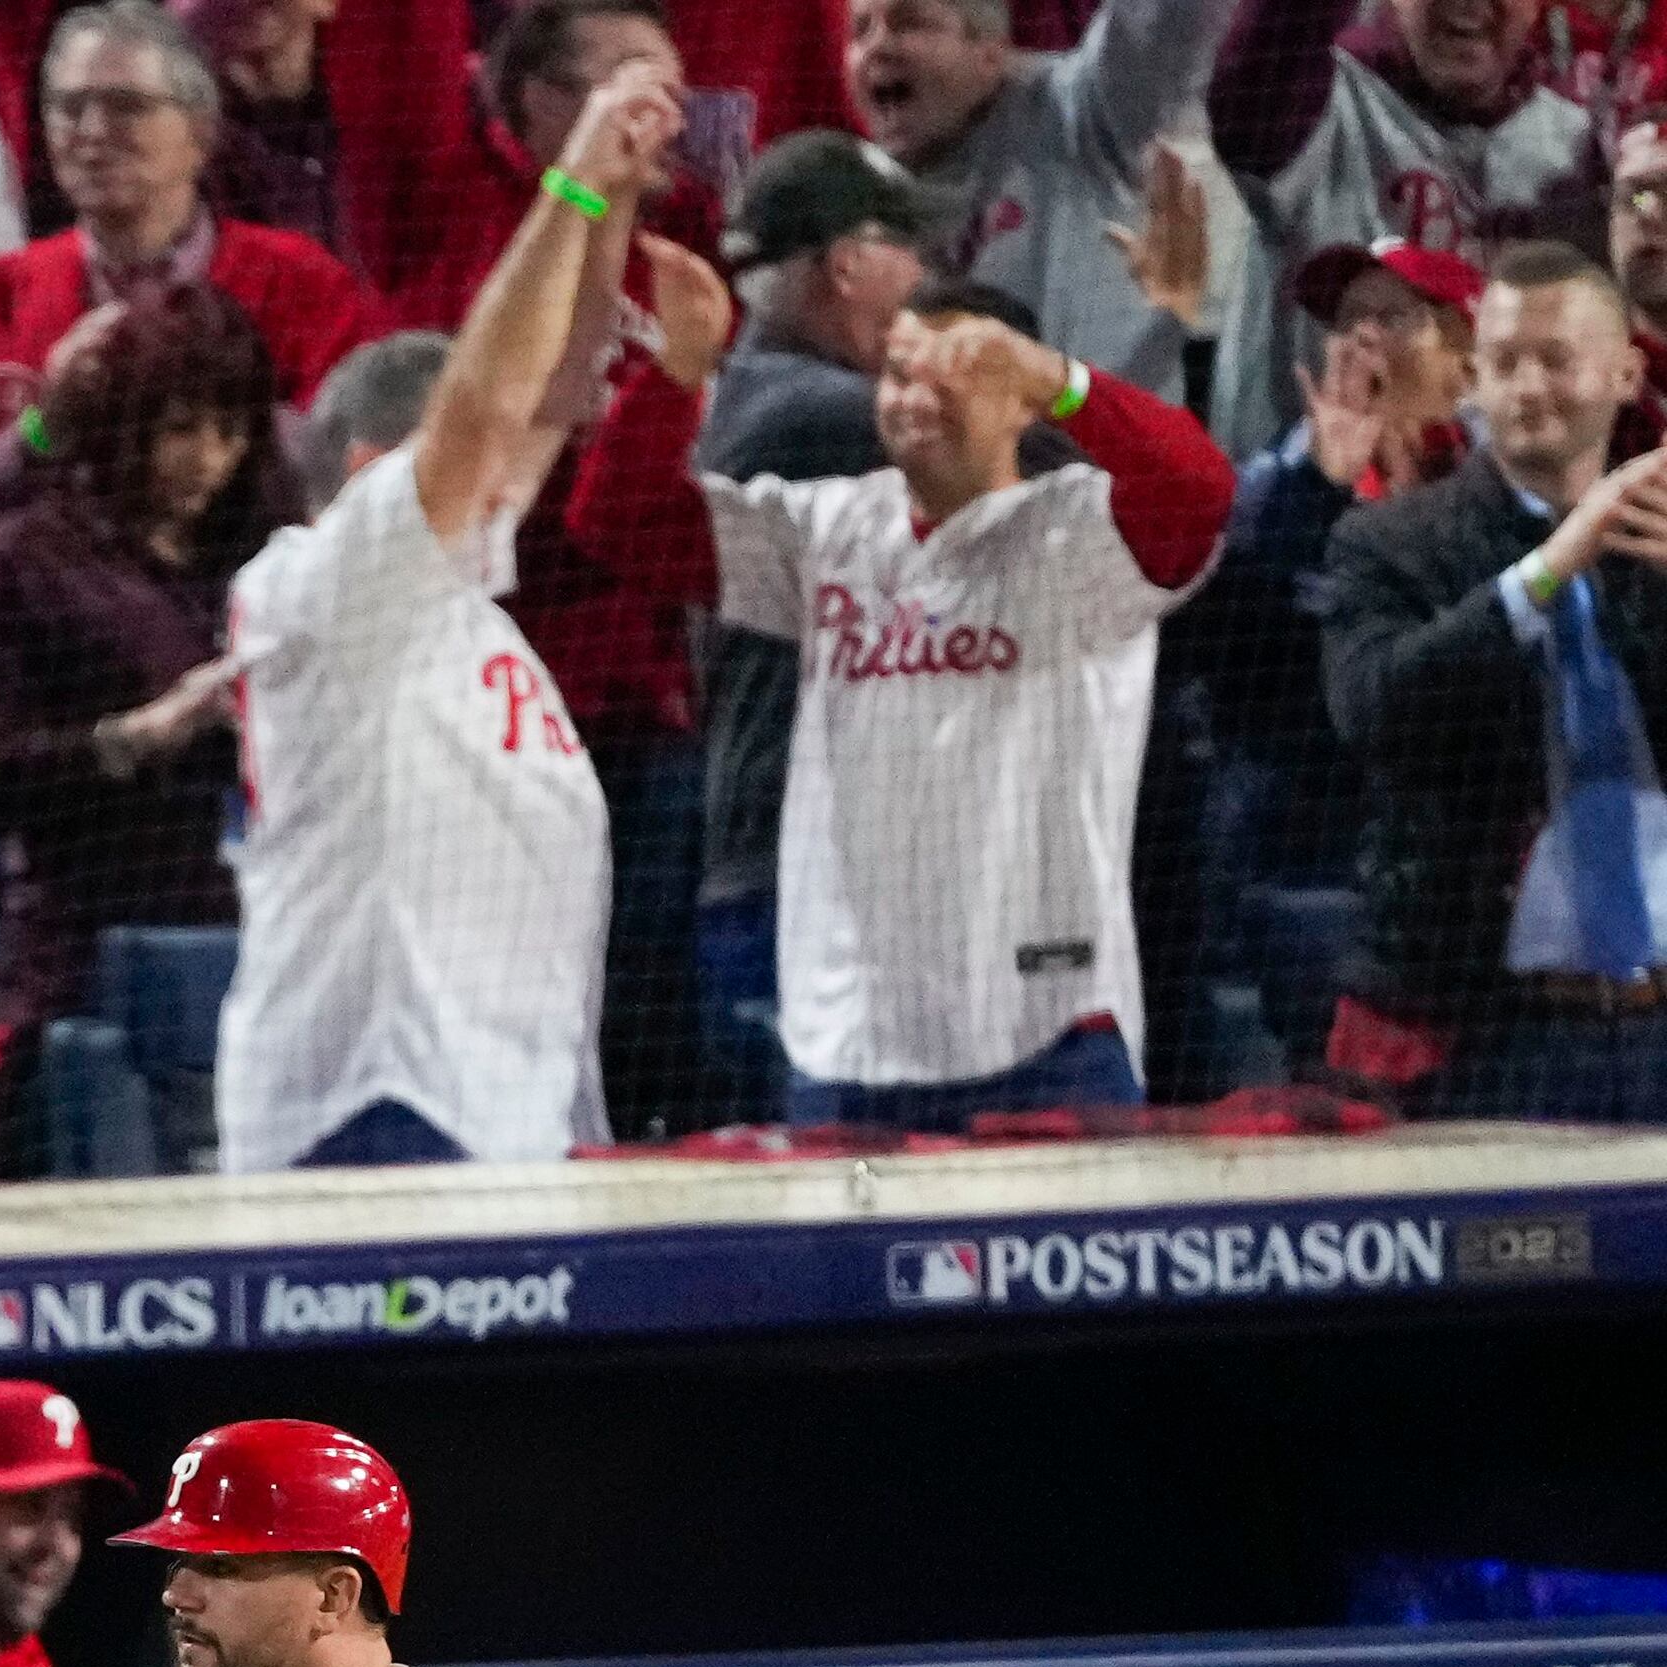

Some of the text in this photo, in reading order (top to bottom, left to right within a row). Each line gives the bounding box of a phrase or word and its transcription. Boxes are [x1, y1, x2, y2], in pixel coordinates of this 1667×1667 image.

[985, 1216, 1445, 1303] POSTSEASON
[31, 1264, 573, 1354] NLCS loanDepot
[168, 1451, 204, 1508] P
